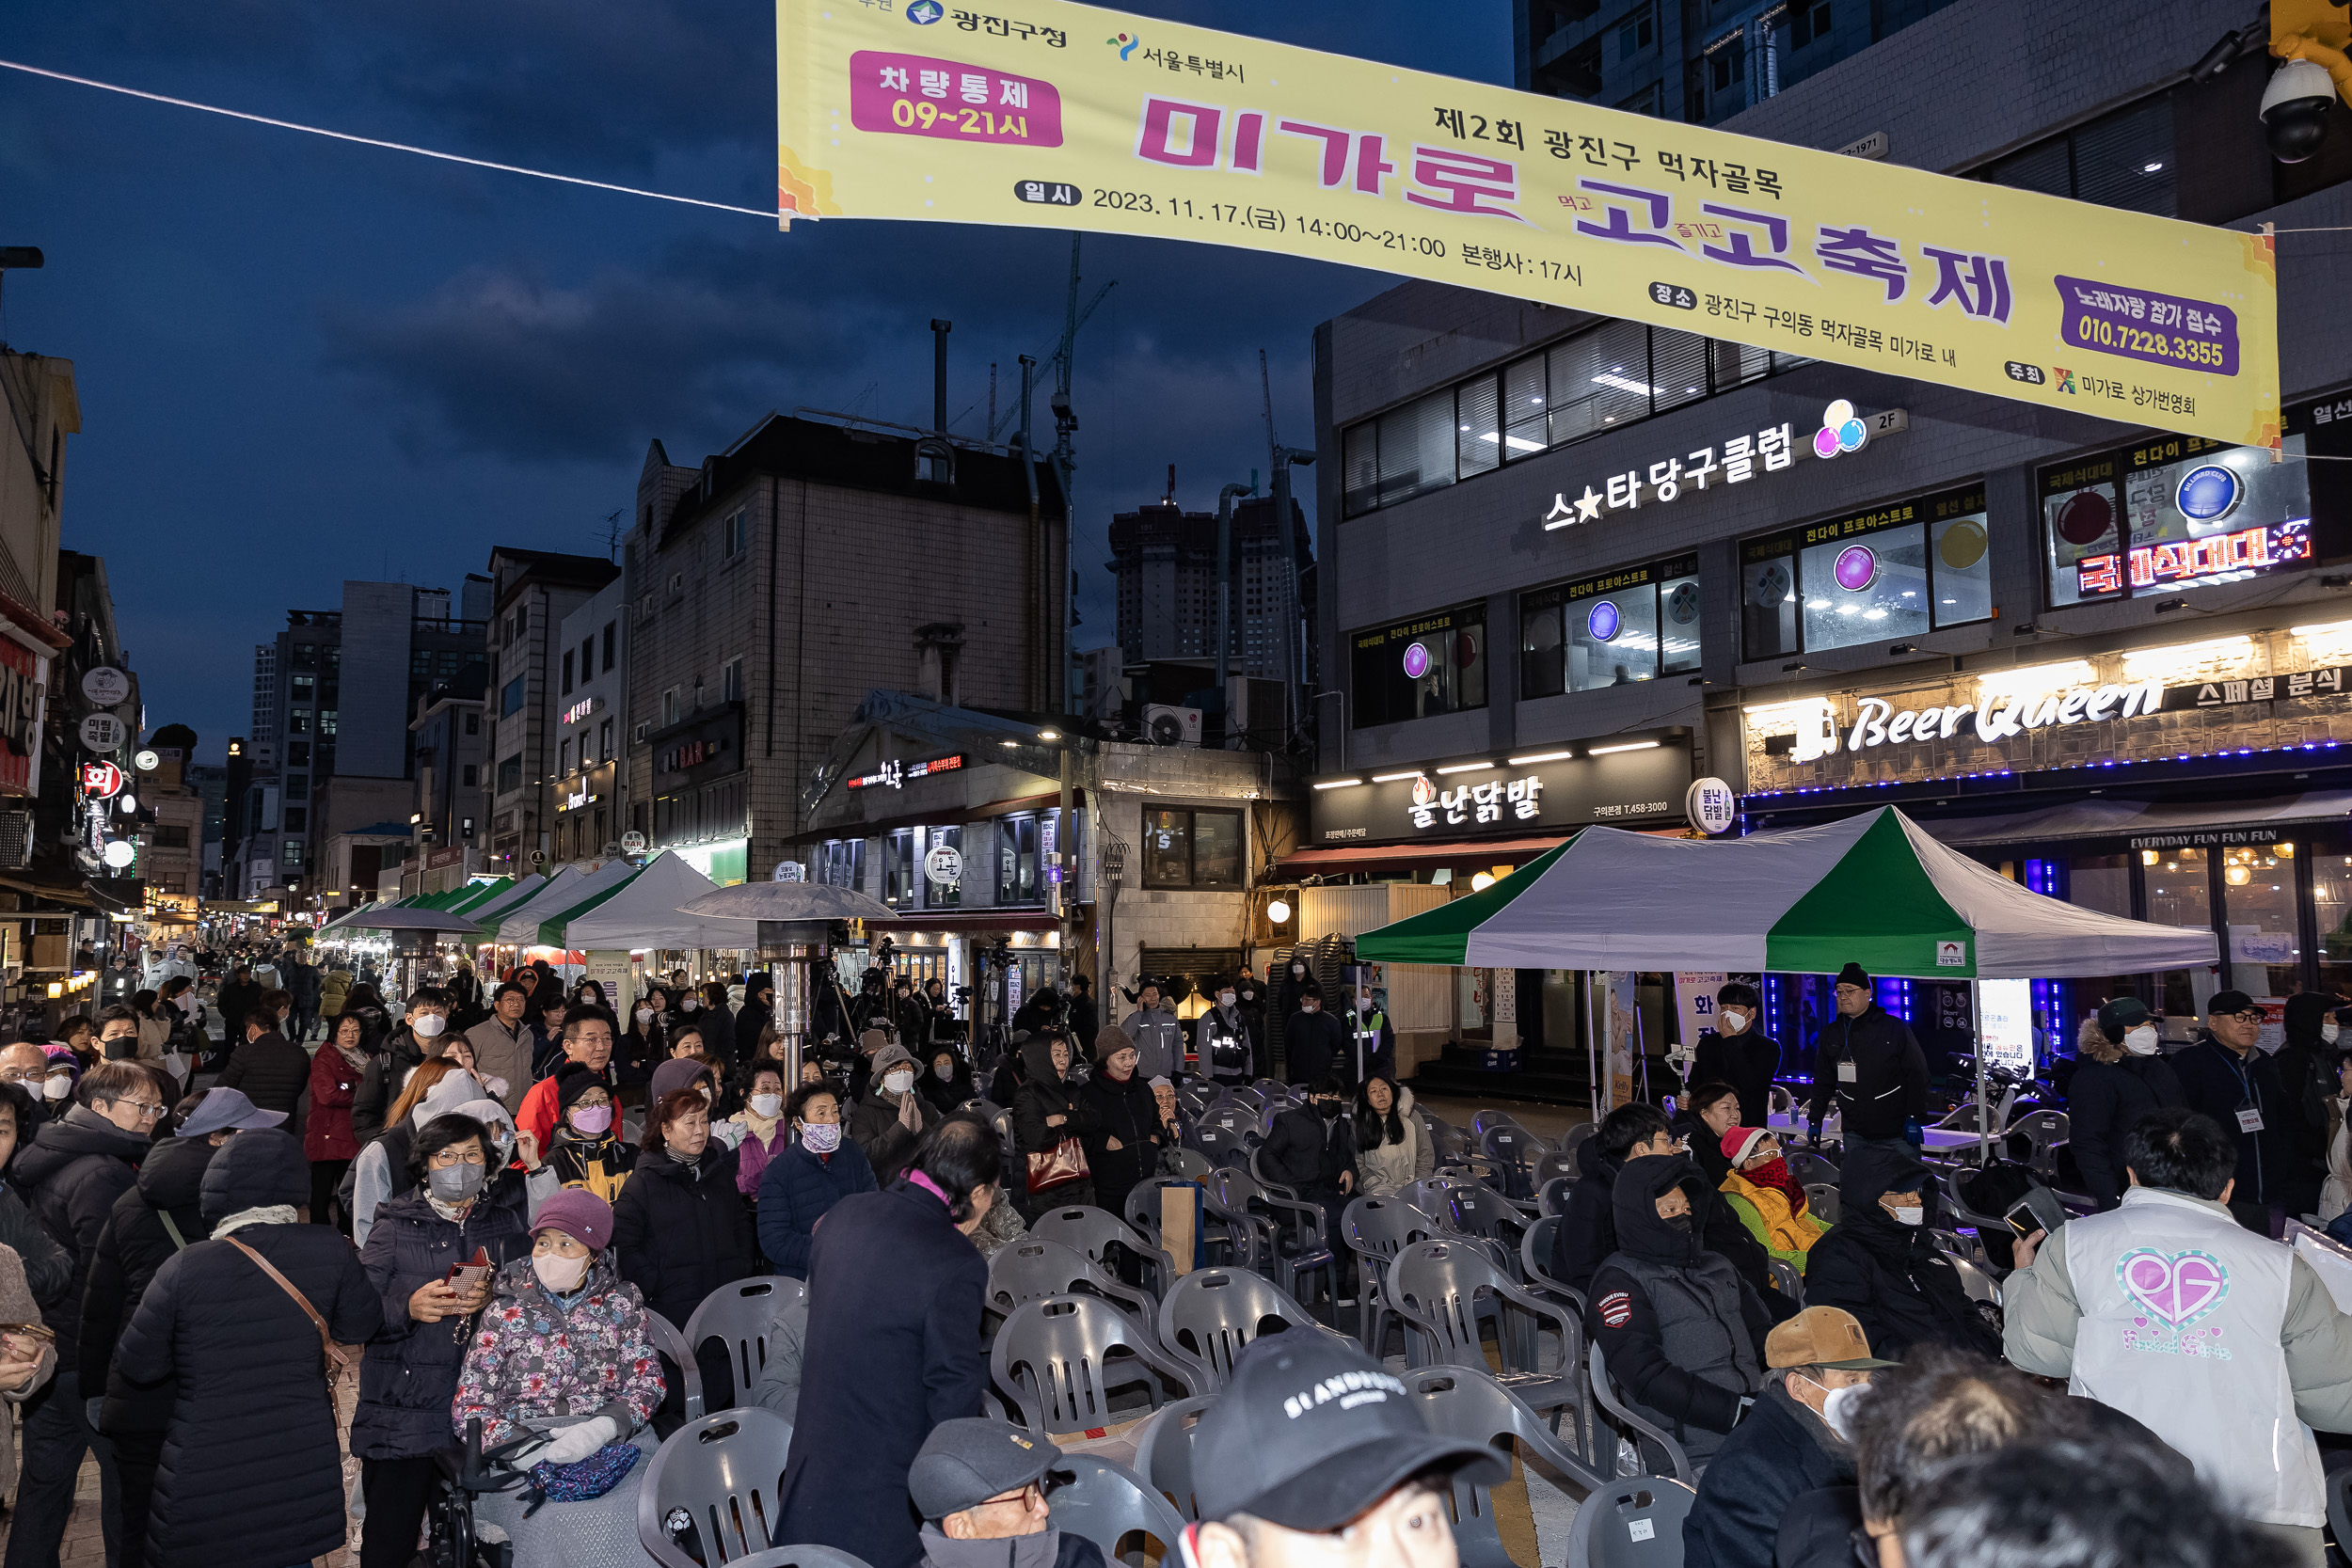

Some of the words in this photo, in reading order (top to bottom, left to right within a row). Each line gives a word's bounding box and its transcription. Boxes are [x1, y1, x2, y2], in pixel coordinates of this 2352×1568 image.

[950, 8, 1068, 48] 광진구청
[1142, 48, 1245, 84] 서울특별시
[892, 98, 1028, 138] 09~21시
[1136, 96, 1527, 223] 미가로
[1434, 106, 1525, 151] 제2회
[1543, 128, 1641, 172] 광진구
[1657, 150, 1783, 200] 먹자골목
[1025, 182, 1072, 204] 일시
[1558, 195, 1592, 212] 먹고
[1296, 215, 1446, 258] 14:00~21:00
[1674, 222, 1724, 240] 즐기고
[1656, 283, 1692, 308] 장소
[2074, 286, 2146, 320] 노래자랑
[2150, 299, 2183, 328] 참가
[2185, 309, 2222, 337] 접수
[1704, 293, 1757, 324] 광진구
[1763, 306, 1814, 337] 구의동
[1820, 319, 1883, 353] 먹자골목
[1890, 335, 1936, 363] 미가로
[1942, 348, 1957, 368] 내
[2078, 314, 2224, 367] 010.7228.3355
[2010, 363, 2041, 383] 주최
[2081, 376, 2126, 400] 미가로
[2131, 385, 2197, 417] 상가번영회
[1879, 412, 1895, 430] 2F
[1649, 422, 1794, 503] 당구클럽
[2134, 441, 2180, 465] 전다이
[2049, 460, 2113, 488] 국제식대대
[2184, 469, 2210, 492] BILLIARD
[2210, 469, 2227, 483] CLUB
[1806, 522, 1838, 543] 전다이
[1843, 505, 1914, 534] 프로아스트로
[1569, 583, 1594, 598] 전다이
[1597, 569, 1647, 592] 프로아스트로
[1390, 626, 1409, 640] 전다이
[1411, 616, 1451, 634] 프로아스트로
[2197, 676, 2275, 706] 스페셜
[2288, 668, 2342, 697] 분식
[1848, 696, 1974, 752] Beer
[1976, 682, 2164, 743] Queen
[85, 766, 114, 794] 회
[1408, 774, 1545, 830] 불난닭발
[1593, 804, 1622, 817] 구의본점
[1624, 800, 1668, 815] T.458-3000
[1703, 788, 1722, 804] 불난
[1703, 804, 1723, 821] 닭발
[2131, 834, 2191, 849] EVERYDAY
[2194, 832, 2218, 846] FUN
[2221, 831, 2248, 844] FUN
[2250, 830, 2277, 842] FUN
